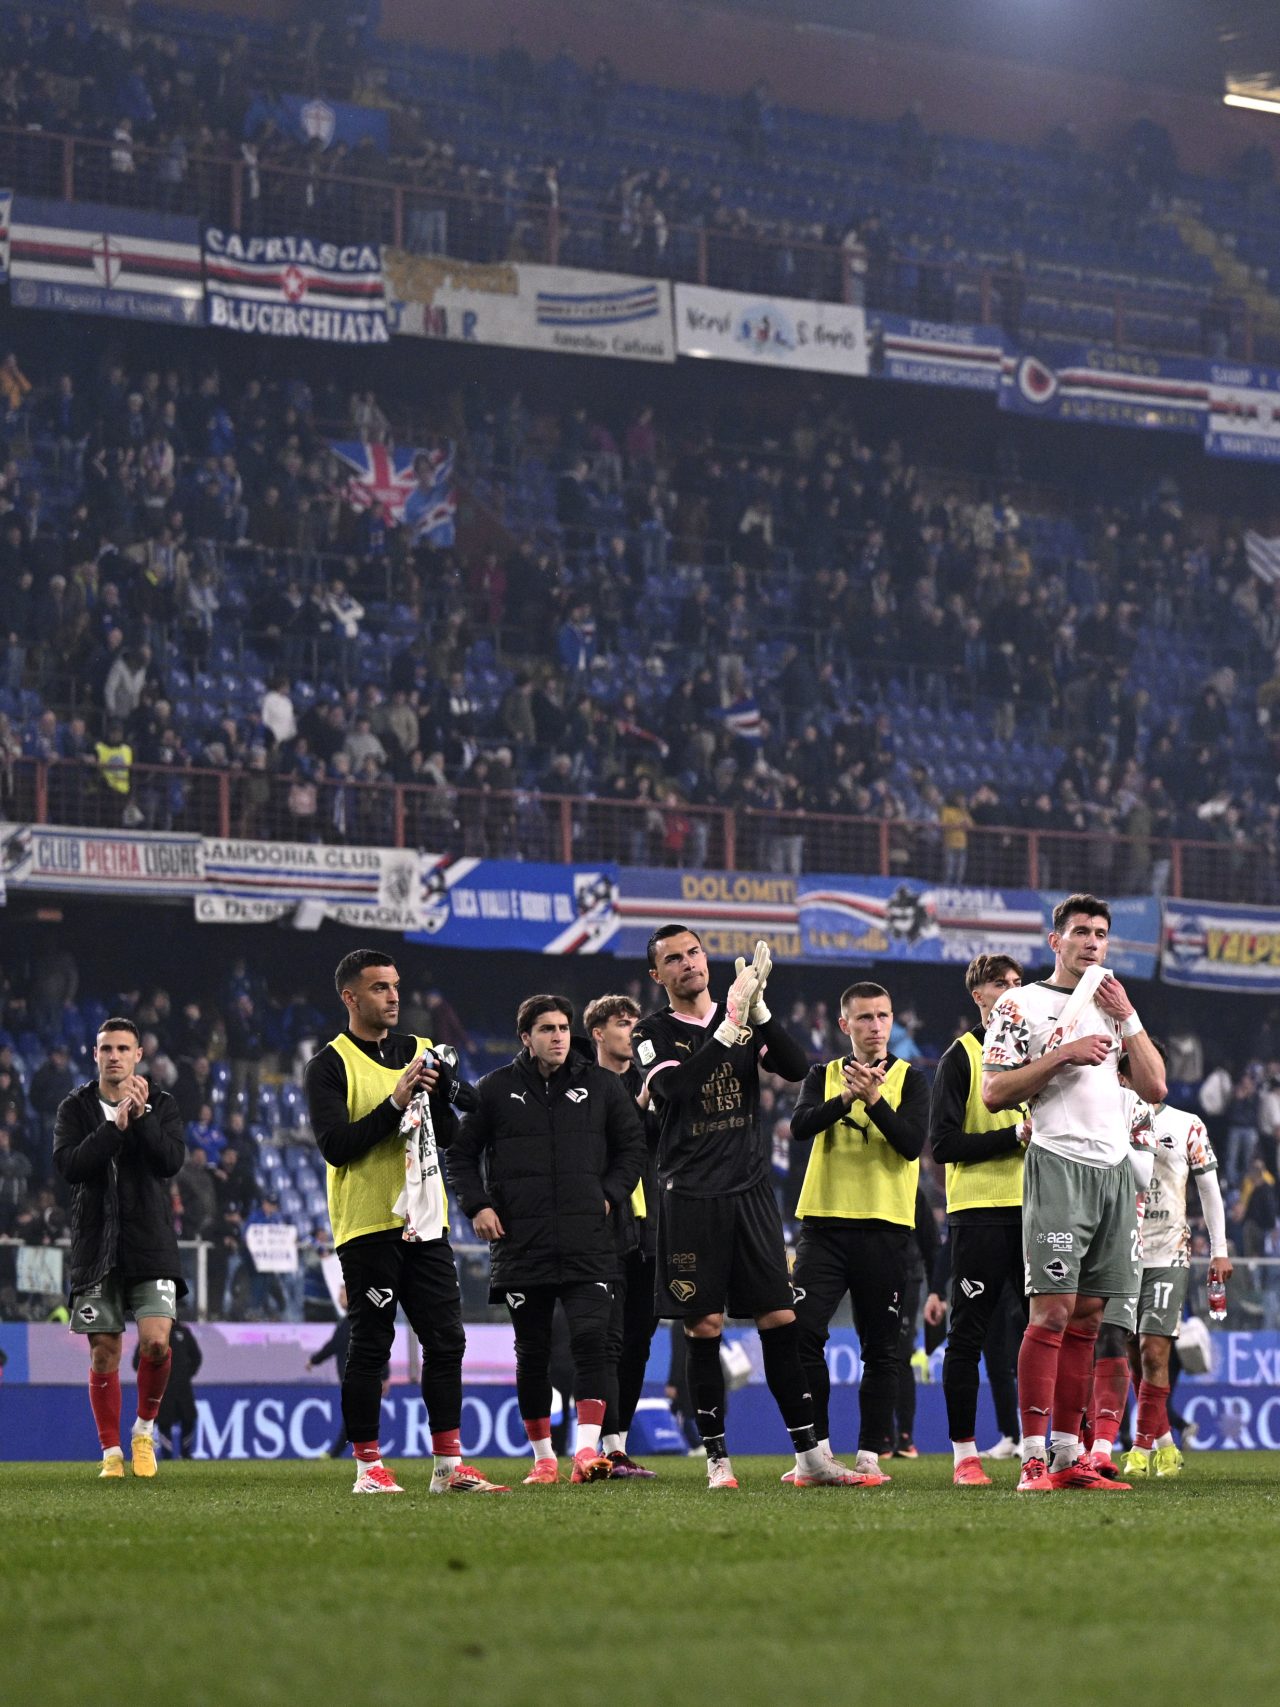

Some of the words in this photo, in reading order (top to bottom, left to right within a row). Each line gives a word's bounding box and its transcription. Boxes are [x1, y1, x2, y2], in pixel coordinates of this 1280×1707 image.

[206, 228, 378, 270] CAPRIASCA
[211, 297, 389, 342] BLUCERCHIATA
[38, 836, 81, 871] CLUB
[85, 840, 142, 875] PIETRA
[144, 841, 199, 878] LIGURE
[1153, 1281, 1174, 1309] 17
[194, 1397, 334, 1459] MSC
